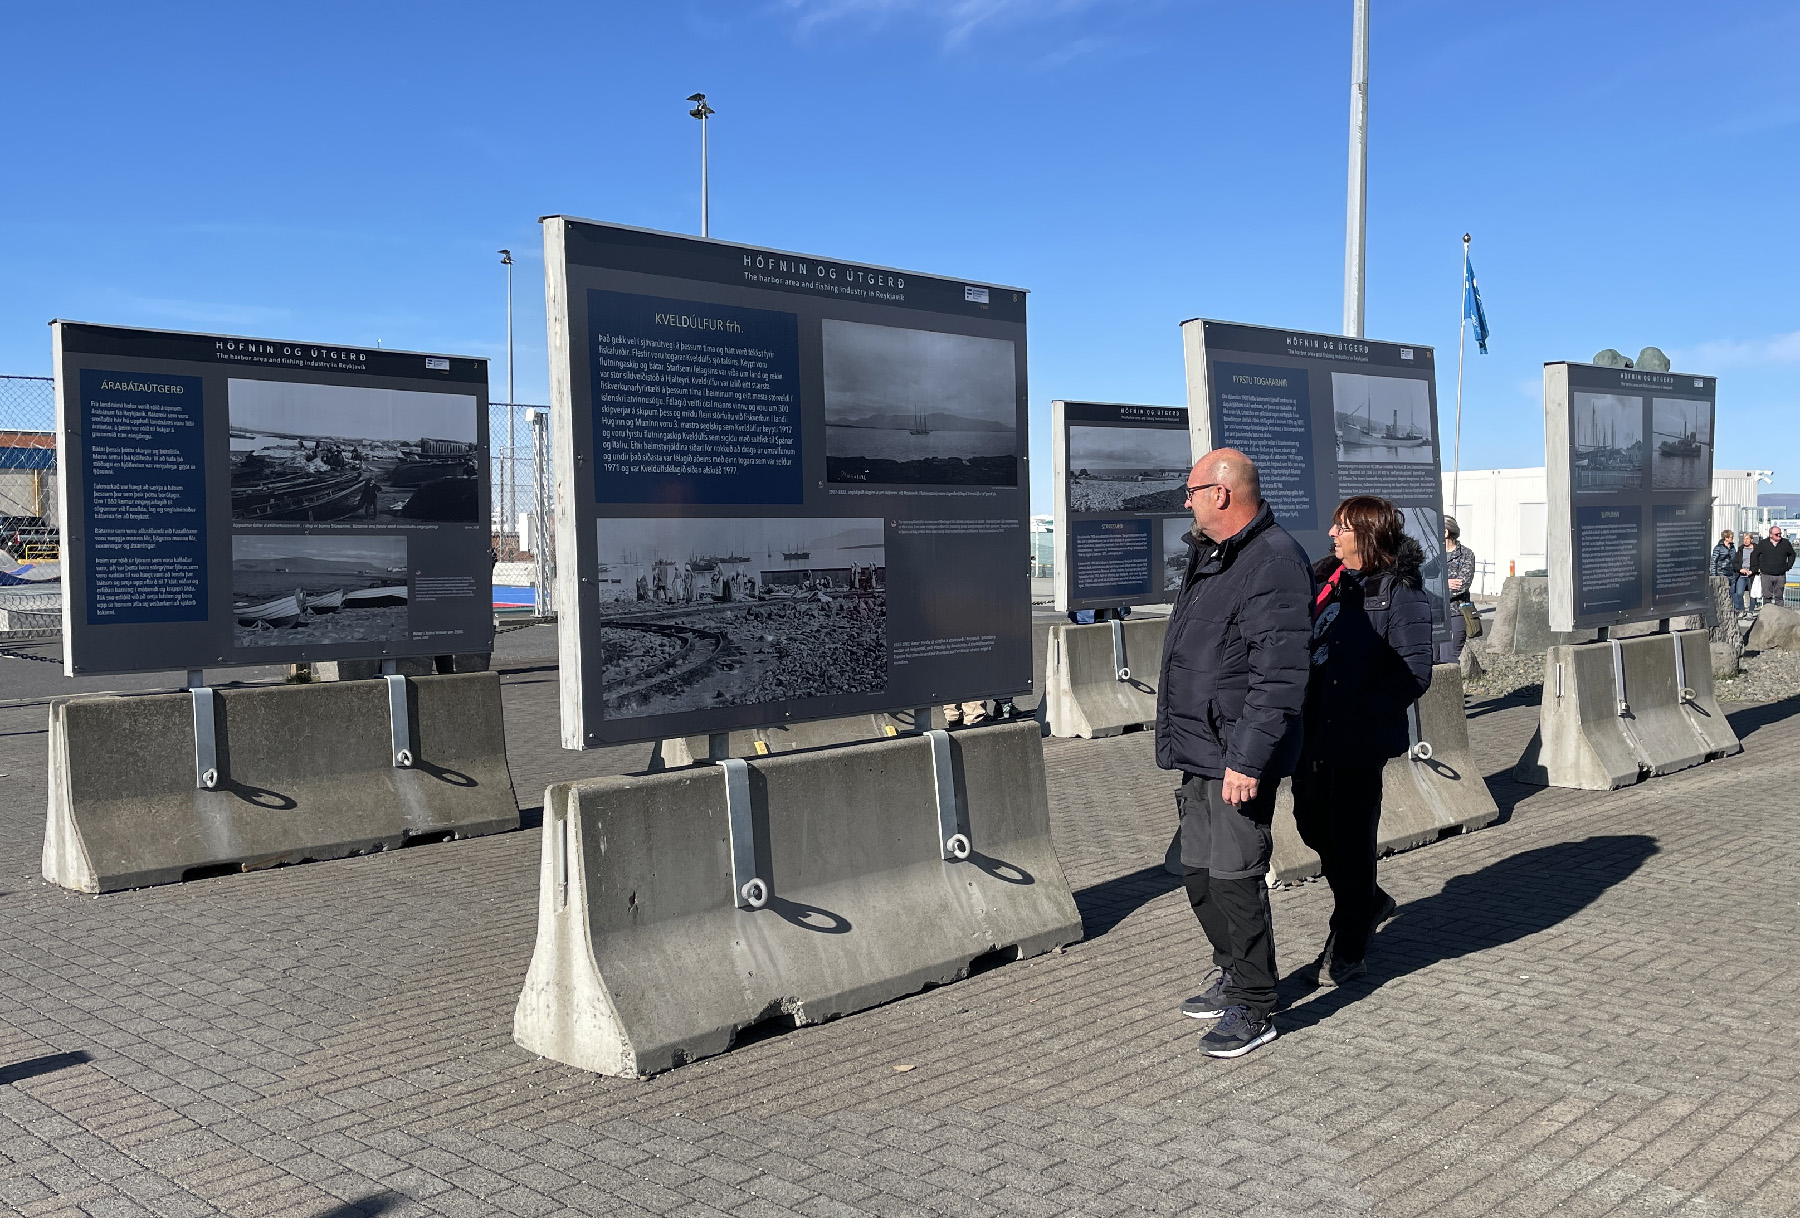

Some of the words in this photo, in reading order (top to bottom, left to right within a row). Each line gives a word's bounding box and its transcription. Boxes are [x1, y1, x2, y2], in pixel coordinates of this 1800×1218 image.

[743, 255, 807, 274] HÖFNIN
[818, 266, 836, 278] OG
[847, 268, 904, 288] ÚTGERÐ
[744, 272, 757, 280] The
[760, 272, 783, 284] harbor
[802, 281, 813, 289] and
[816, 282, 838, 293] fishing
[840, 286, 866, 297] industry
[1013, 294, 1017, 302] 8
[656, 313, 723, 331] KVELDÚLFUR
[726, 320, 743, 333] frh.
[1287, 337, 1318, 348] HÖFNIN
[1324, 342, 1333, 350] OG
[216, 340, 273, 353] HÖFNIN
[284, 347, 301, 355] OG
[311, 348, 365, 360] ÚTGERÐ
[715, 347, 723, 355] og
[282, 358, 303, 366] fishing
[305, 360, 330, 368] industry
[640, 363, 647, 371] og
[101, 379, 183, 393] ÁRABÁTAÚTGERÐ
[666, 386, 688, 396] þessum
[636, 407, 658, 417] skipum
[659, 408, 672, 418] þess
[625, 419, 633, 427] og
[602, 430, 610, 438] og
[602, 442, 611, 450] og
[602, 453, 611, 461] og
[630, 452, 641, 462] það
[604, 463, 619, 471] 1971
